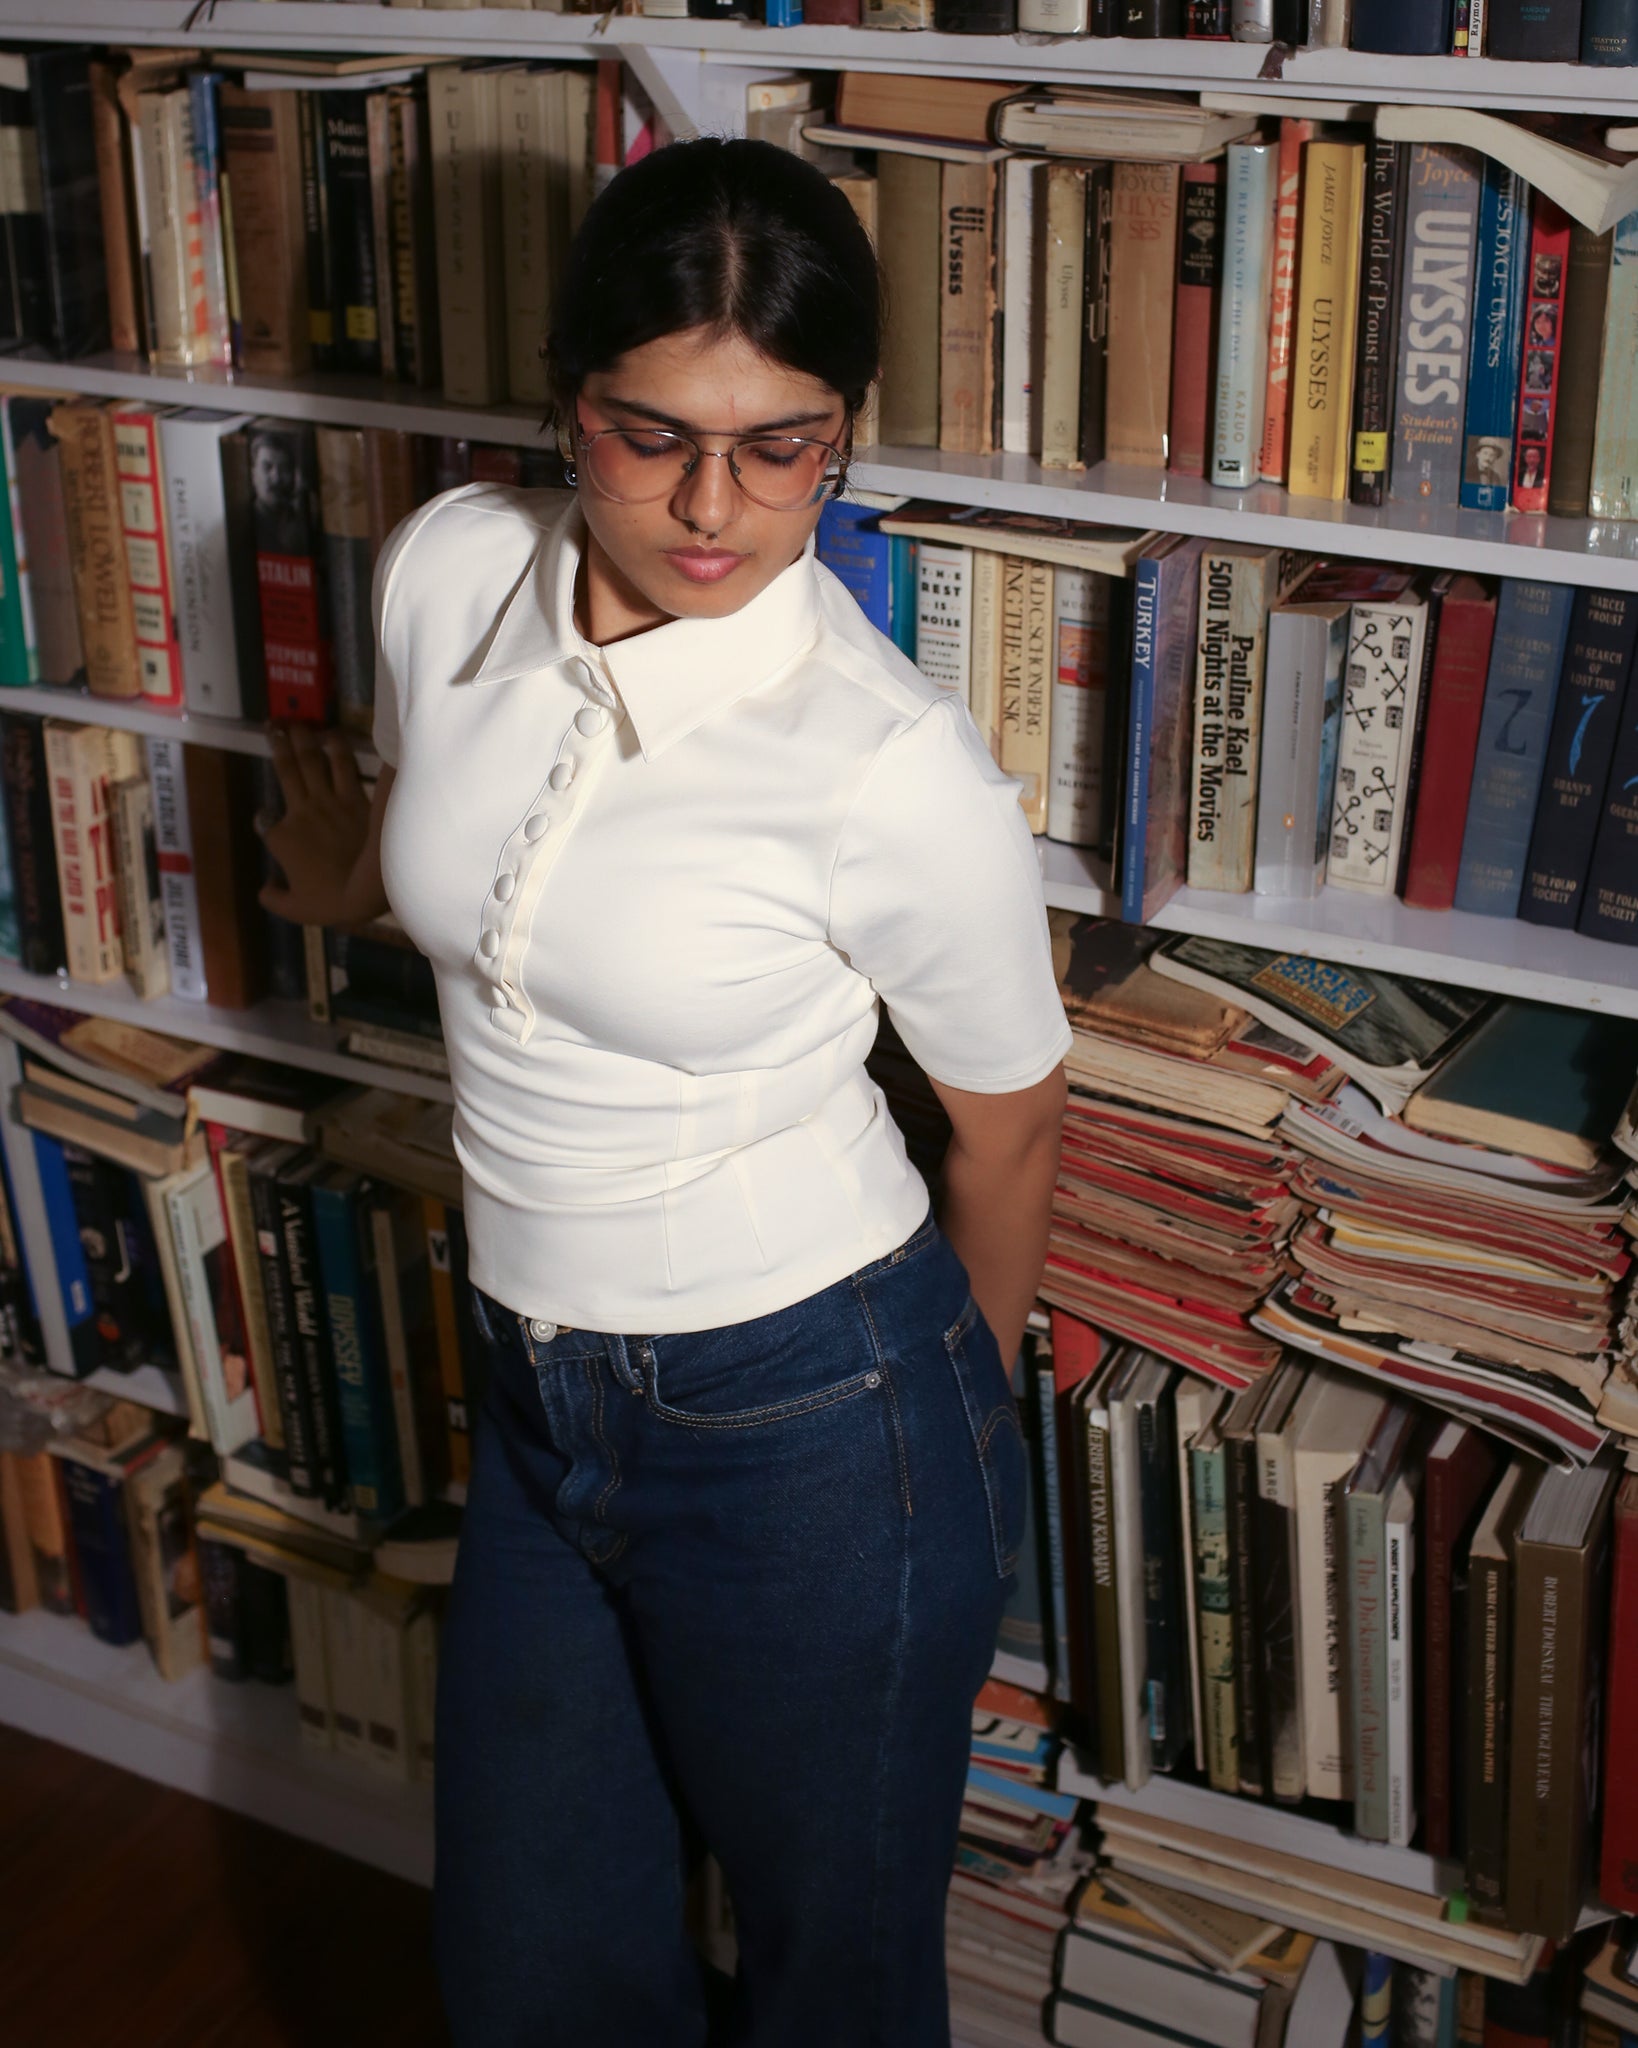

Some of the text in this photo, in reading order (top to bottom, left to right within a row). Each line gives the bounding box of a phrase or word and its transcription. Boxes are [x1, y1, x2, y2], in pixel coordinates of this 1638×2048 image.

[1373, 142, 1395, 183] The
[1417, 163, 1473, 188] Joyce
[1319, 162, 1337, 265] JAMES JOYCE
[1370, 190, 1393, 259] World
[1367, 266, 1388, 292] of
[1491, 224, 1512, 289] JOYCE
[1363, 295, 1388, 363] Proust
[1402, 210, 1472, 405] ULYSSES
[1486, 297, 1507, 369] Ulysses
[1307, 298, 1334, 411] ULYSSES
[1400, 412, 1459, 430] Student's
[1402, 427, 1453, 445] Edition
[921, 582, 962, 598] REST
[934, 601, 947, 612] IS
[921, 614, 961, 628] NOISE
[1003, 611, 1023, 664] THE
[1134, 576, 1157, 670] TURKEY
[1587, 608, 1625, 627] PROUST
[1025, 625, 1044, 737] SCHONBERG
[1585, 646, 1623, 665] SEARCH
[1588, 662, 1603, 675] OF
[1001, 666, 1022, 734] MUSIC
[1197, 560, 1233, 843] 5001 Nights at the Movies
[1224, 635, 1255, 777] Pauline Kael
[1547, 876, 1577, 892] FOLIO
[1091, 1522, 1112, 1588] KARAJAN
[1542, 1575, 1559, 1627] ROBERT
[1357, 1558, 1382, 1793] The Dickinsons of Amherst
[1539, 1694, 1555, 1720] THE
[1535, 1760, 1552, 1800] YEARS
